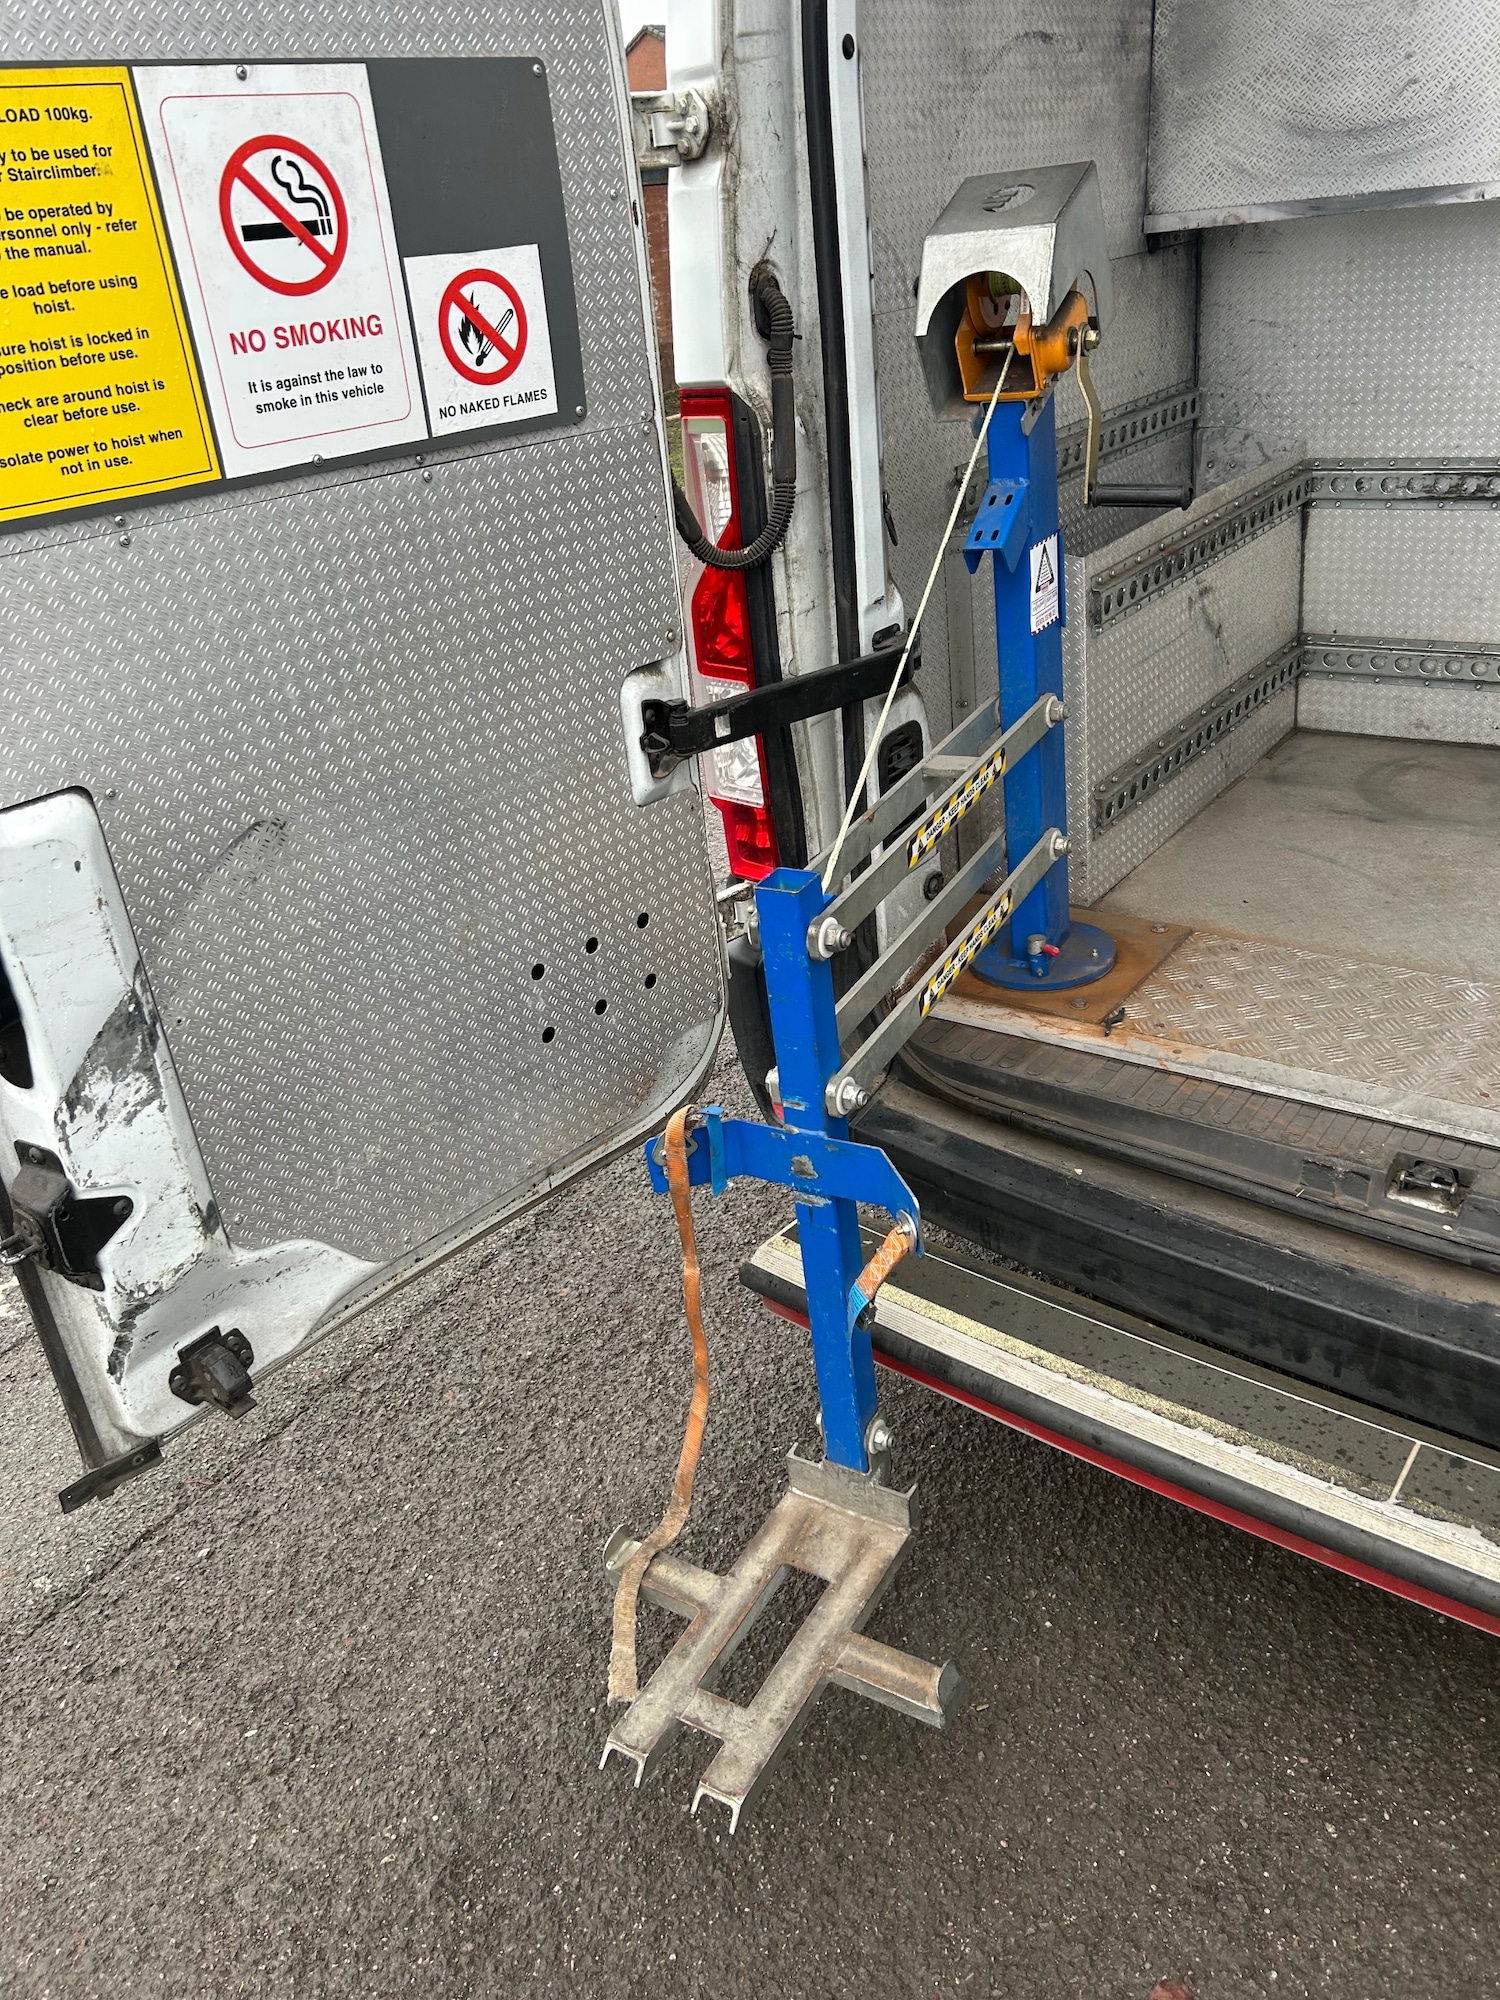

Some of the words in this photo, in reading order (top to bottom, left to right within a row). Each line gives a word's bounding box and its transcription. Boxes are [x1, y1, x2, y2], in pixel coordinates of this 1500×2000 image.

[45, 107, 93, 122] 100kg.
[11, 149, 26, 161] to
[30, 147, 50, 160] be
[54, 145, 89, 159] used
[93, 144, 112, 157] for
[8, 165, 101, 181] Stairclimber.
[5, 208, 24, 221] be
[28, 202, 92, 222] operated
[96, 202, 113, 217] by
[0, 224, 57, 240] rsonnel
[62, 222, 91, 237] only
[106, 219, 137, 232] refer
[5, 246, 30, 259] the
[34, 240, 91, 257] manual.
[12, 282, 45, 298] load
[48, 280, 95, 294] before
[99, 275, 138, 290] using
[33, 300, 75, 315] hoist.
[30, 337, 67, 352] hoist
[70, 335, 83, 348] is
[87, 329, 133, 346] locked
[137, 328, 150, 339] in
[229, 329, 266, 355] NO
[274, 314, 384, 349] SMOKING
[60, 353, 106, 367] before
[110, 350, 138, 361] use.
[248, 381, 257, 394] It
[261, 379, 272, 393] is
[276, 371, 322, 392] against
[325, 369, 344, 382] the
[347, 366, 367, 379] law
[371, 363, 383, 375] to
[36, 396, 59, 407] are
[63, 388, 112, 403] around
[115, 381, 150, 396] hoist
[153, 379, 165, 390] is
[255, 398, 298, 414] smoke
[300, 394, 312, 407] in
[316, 390, 338, 404] this
[342, 382, 385, 400] vehicle
[439, 405, 456, 420] NO
[460, 398, 500, 415] NAKED
[503, 388, 548, 408] FLAMES
[24, 414, 58, 427] clear
[63, 407, 108, 421] before
[112, 402, 140, 415] use.
[47, 444, 89, 463] power
[94, 441, 108, 452] to
[111, 433, 145, 450] hoist
[149, 429, 183, 443] when
[61, 461, 84, 476] not
[87, 459, 100, 471] in
[104, 456, 133, 467] use.
[926, 817, 946, 841] DANGER
[948, 801, 961, 816] KEEP
[961, 785, 976, 804] HANDS
[975, 771, 990, 791] CLEAR
[937, 963, 955, 989] DANGER
[958, 947, 970, 962] KEEP
[969, 931, 984, 951] HANDS
[983, 914, 997, 934] CLEAR
